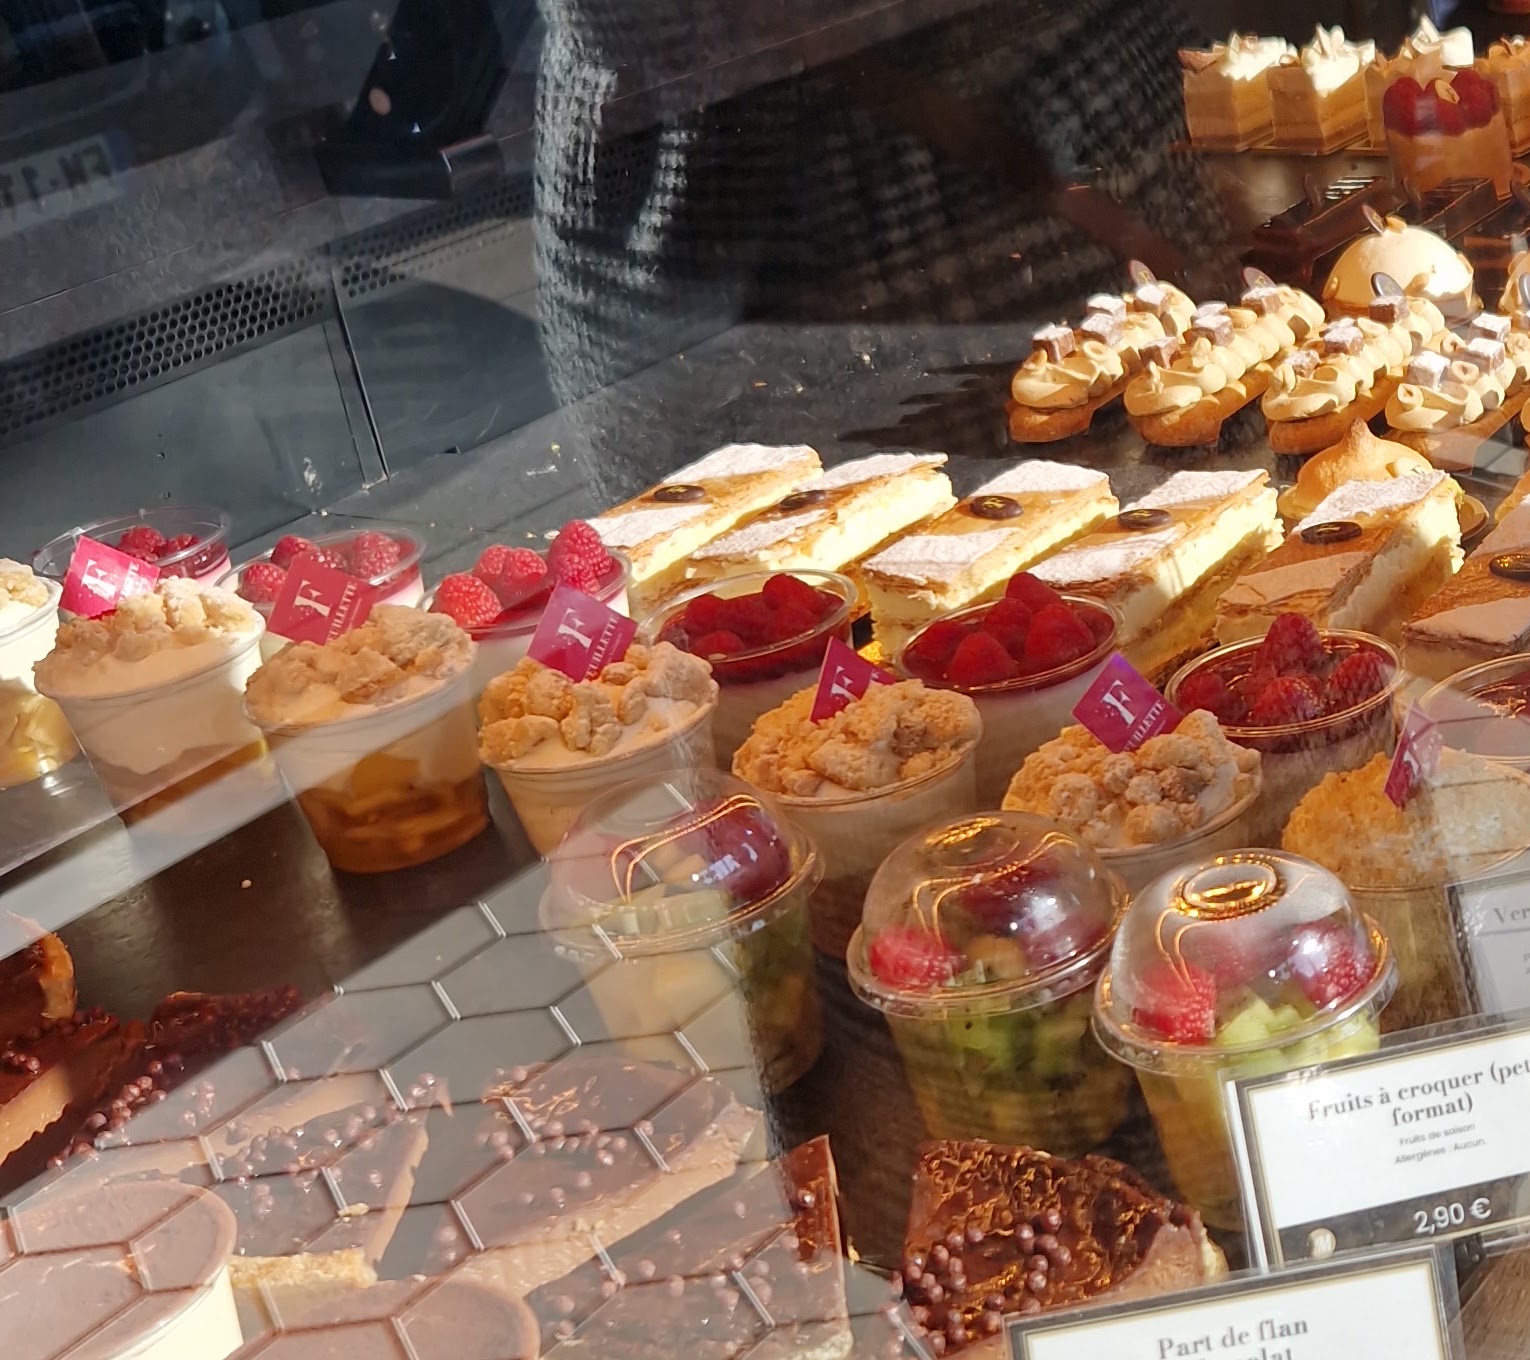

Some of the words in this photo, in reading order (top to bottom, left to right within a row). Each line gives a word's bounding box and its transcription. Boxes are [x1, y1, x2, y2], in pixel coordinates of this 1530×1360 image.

[80, 558, 119, 603] F
[292, 579, 333, 619] F
[325, 580, 359, 641] EUILLETTE
[555, 606, 595, 653] F
[1100, 679, 1138, 728] F
[1306, 1089, 1376, 1123] Fruits
[1379, 1086, 1393, 1107] à
[1397, 1066, 1485, 1105] croquer
[1391, 1092, 1476, 1129] format)
[1394, 1146, 1448, 1165] Allergènes
[1399, 1134, 1427, 1147] Fruits
[1428, 1130, 1442, 1141] de
[1443, 1122, 1477, 1138] saison
[1411, 1199, 1466, 1237] 2,90
[1468, 1195, 1494, 1221] €
[1220, 1324, 1251, 1352] de
[1256, 1315, 1311, 1345] flan
